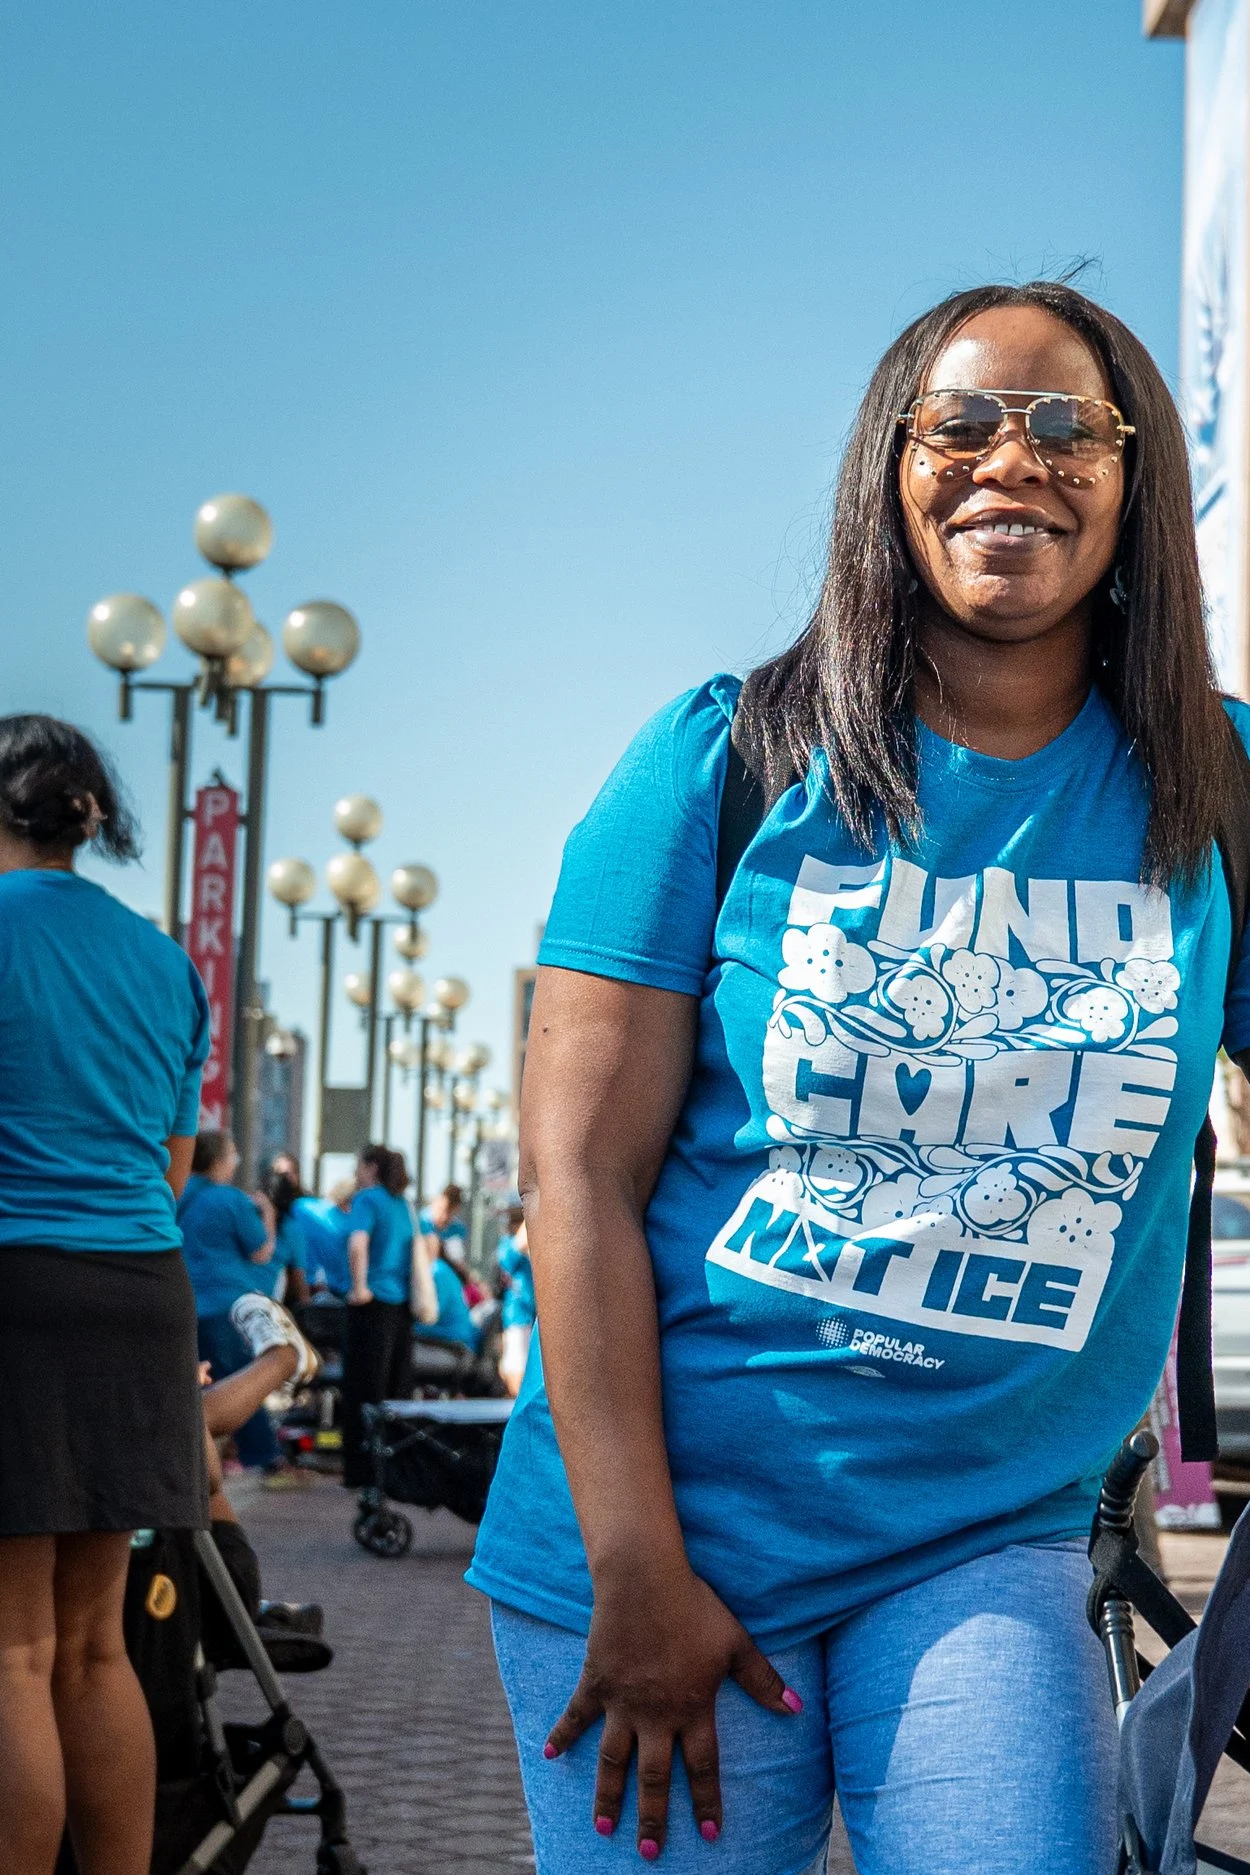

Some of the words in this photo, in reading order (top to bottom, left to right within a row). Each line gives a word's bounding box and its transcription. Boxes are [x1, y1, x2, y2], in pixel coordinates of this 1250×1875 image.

[787, 854, 1174, 963] FUND
[763, 1030, 1178, 1158] CARE
[921, 1249, 1084, 1331] ICE
[848, 1339, 946, 1370] DEMOCRACY
[853, 1328, 926, 1356] POPULAR
